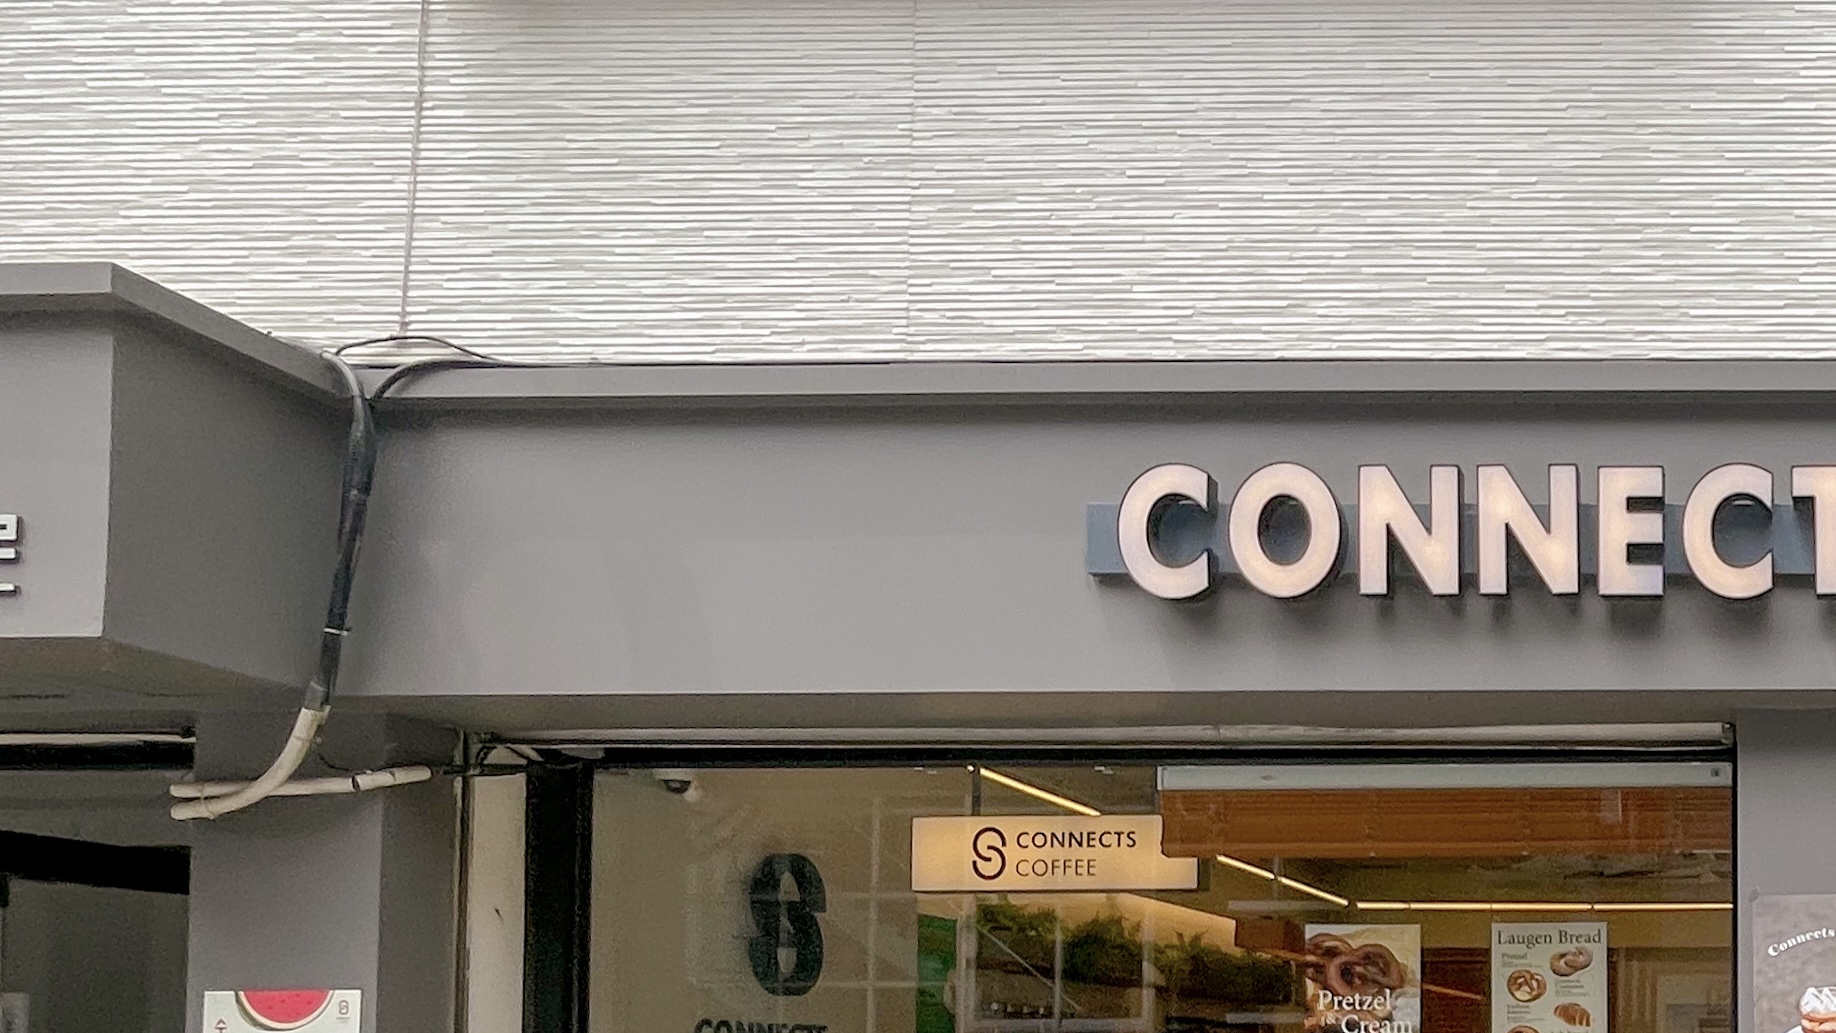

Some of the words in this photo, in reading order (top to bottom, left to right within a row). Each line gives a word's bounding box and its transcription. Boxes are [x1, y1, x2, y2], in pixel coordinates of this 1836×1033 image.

[1015, 831, 1137, 849] CONNECTS
[1015, 859, 1098, 877] COFFEE
[1497, 929, 1553, 949] Laugen
[1557, 928, 1602, 944] Bread
[1767, 926, 1836, 957] Connects
[1317, 987, 1392, 1011] Pretzel
